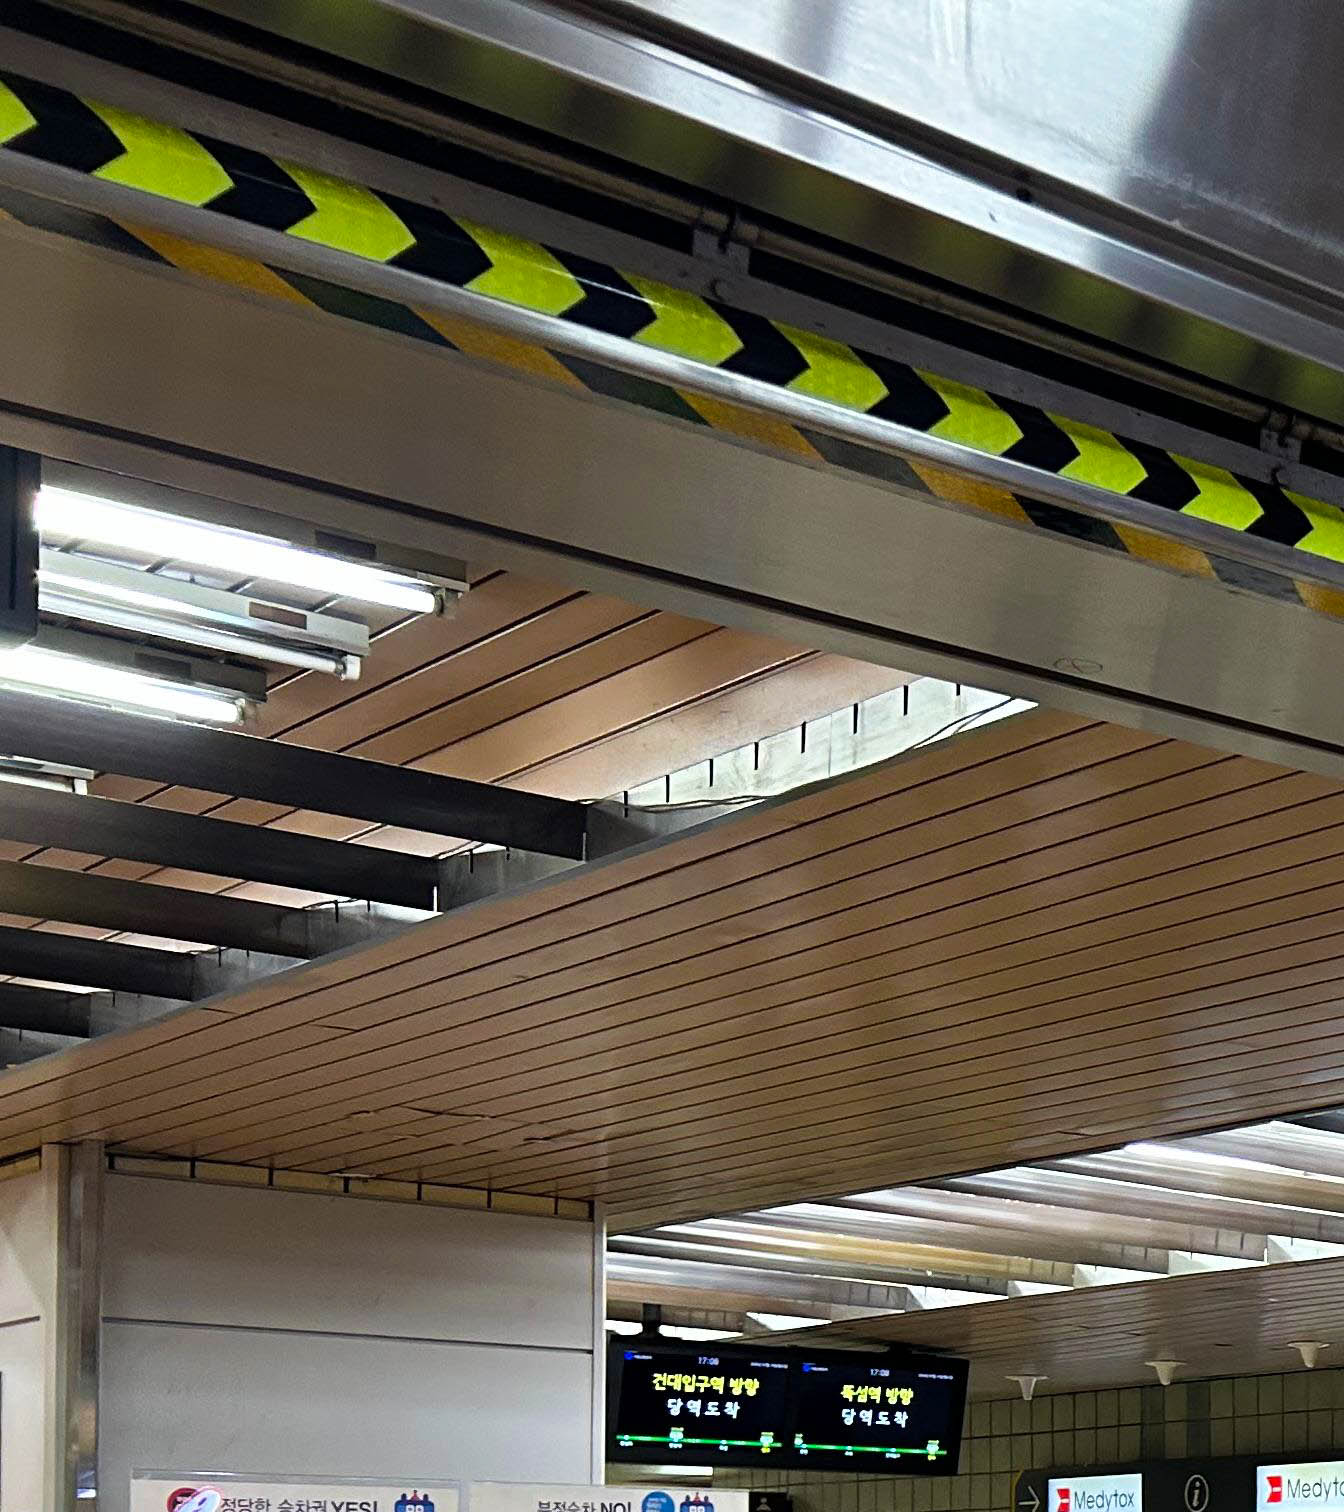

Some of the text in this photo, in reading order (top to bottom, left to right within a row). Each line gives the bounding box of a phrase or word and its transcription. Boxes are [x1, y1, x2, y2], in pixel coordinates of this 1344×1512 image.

[652, 1373, 760, 1396] 건대입구역 방향
[886, 1387, 914, 1405] 방향
[1074, 1490, 1135, 1512] Medytox
